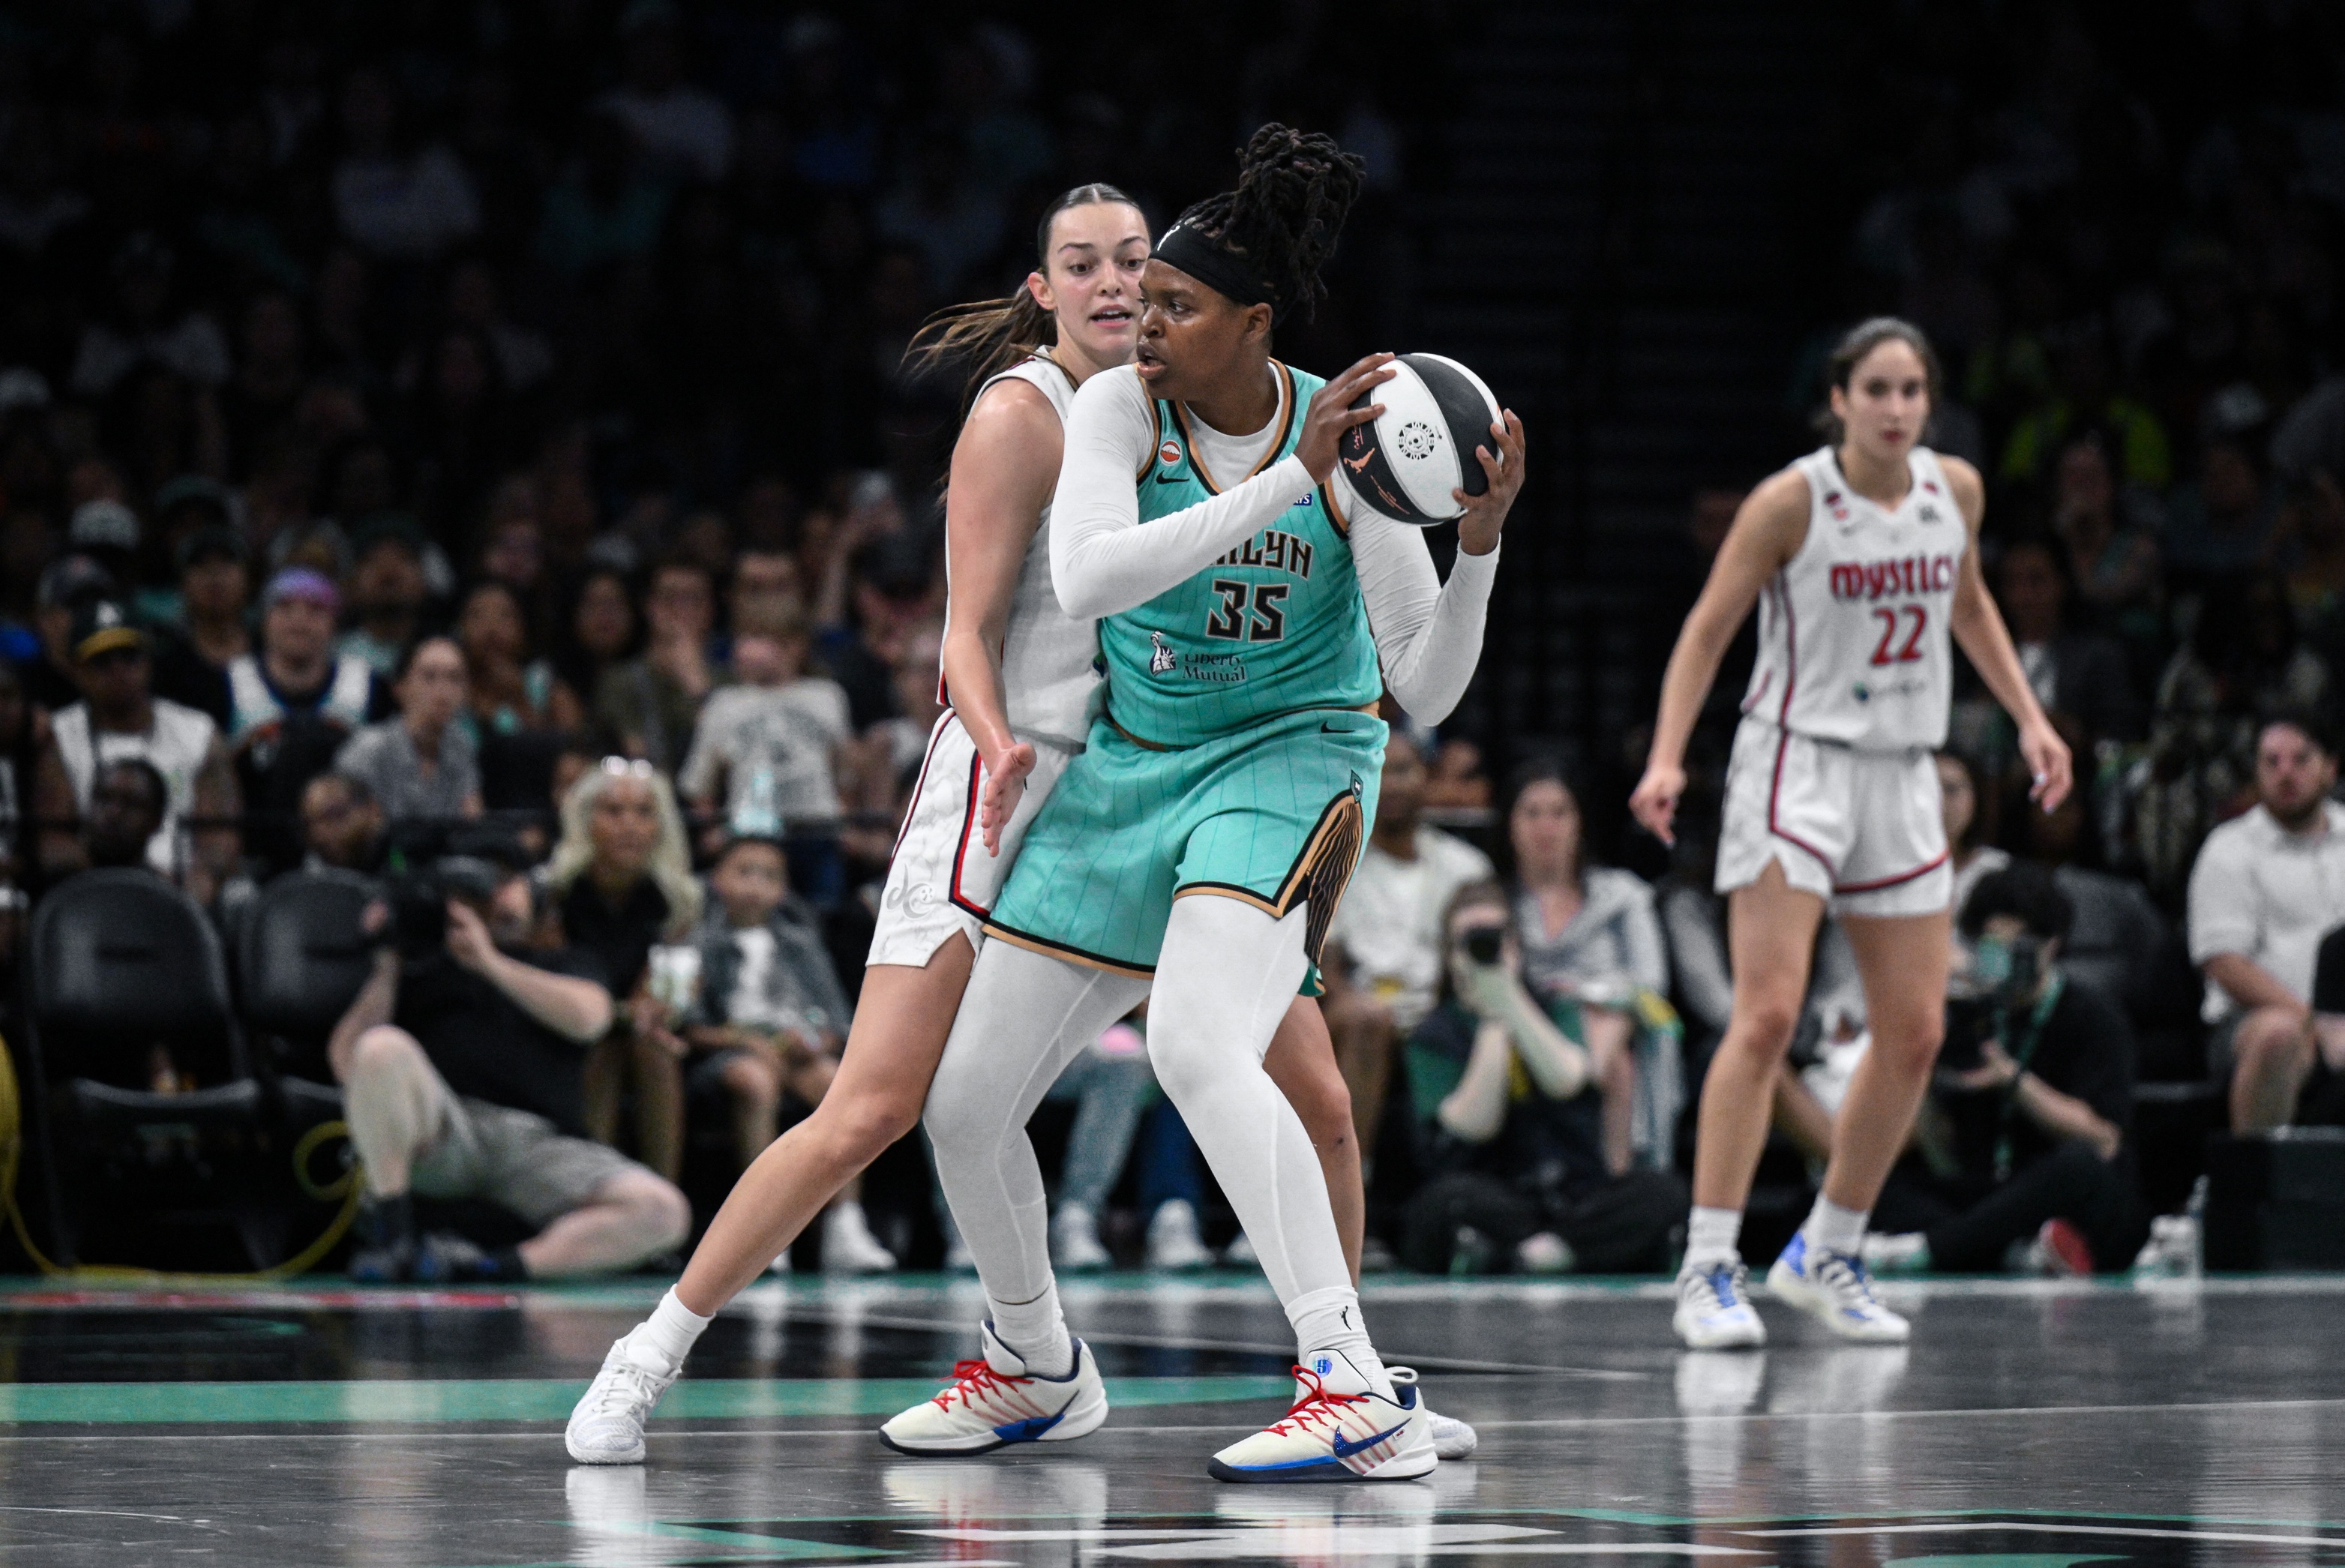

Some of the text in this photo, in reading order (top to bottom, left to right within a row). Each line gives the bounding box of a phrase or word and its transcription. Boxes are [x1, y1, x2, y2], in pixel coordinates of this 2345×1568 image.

[1210, 529, 1313, 581] LYN
[1206, 579, 1290, 643] 35
[1870, 604, 1928, 667] 22
[1183, 665, 1246, 682] Mutual
